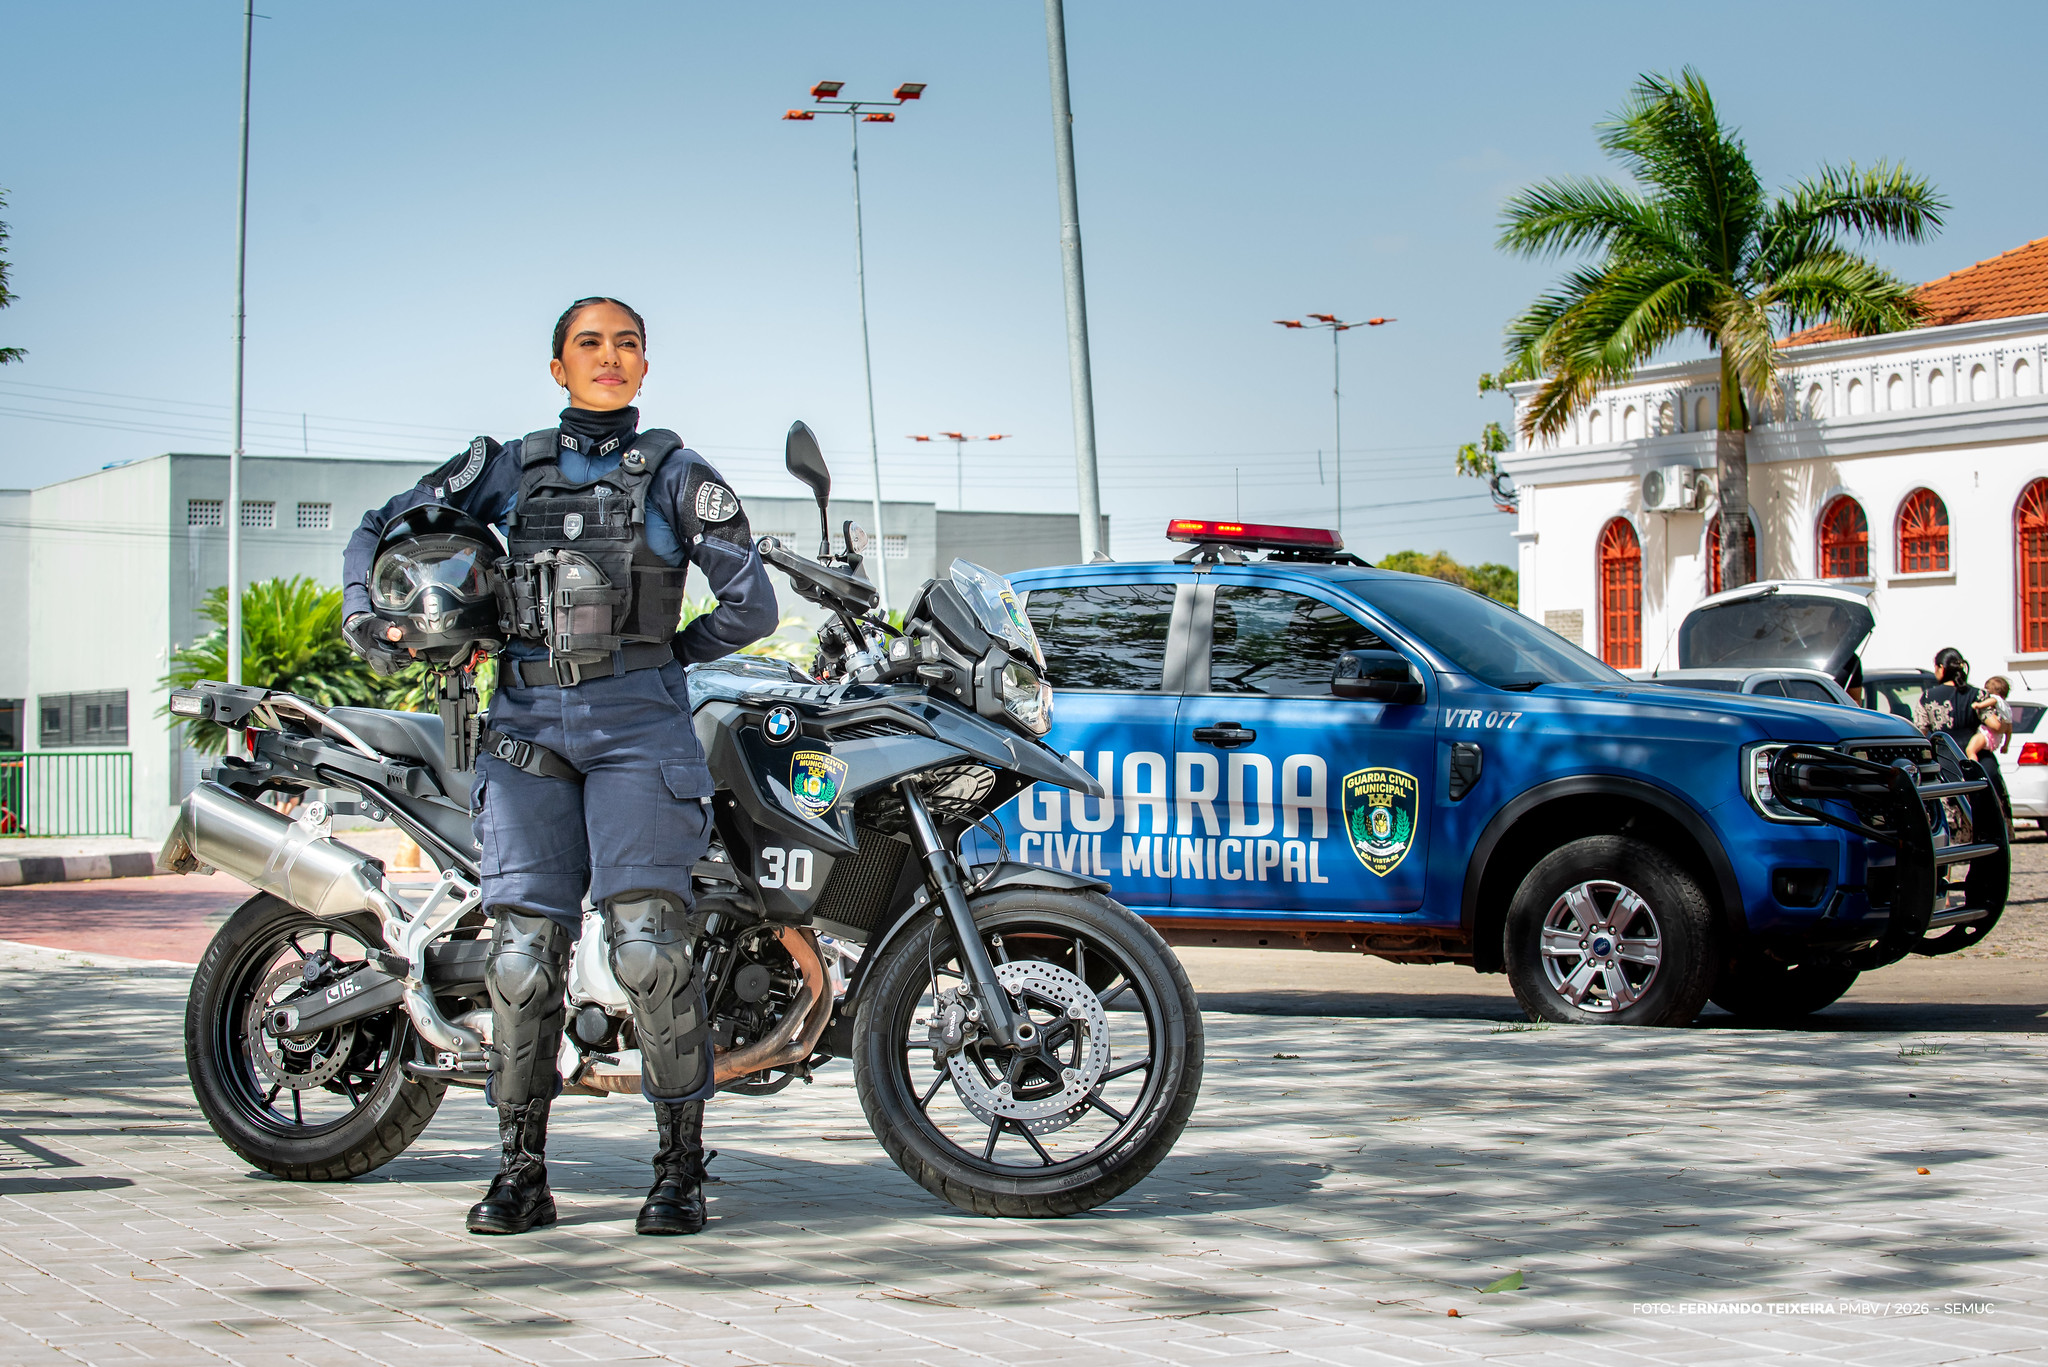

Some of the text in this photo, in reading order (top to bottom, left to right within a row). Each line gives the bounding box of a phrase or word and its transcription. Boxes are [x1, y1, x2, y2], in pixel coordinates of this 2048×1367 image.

[453, 440, 483, 488] BOA VISTA
[709, 487, 724, 519] GAM
[1445, 708, 1523, 729] VTR 077
[795, 753, 844, 772] GUARDA CIVIL
[799, 760, 837, 775] MUNICIPAL
[1347, 772, 1414, 791] GUARDA CIVIL
[1354, 783, 1407, 798] MUNICIPAL
[1018, 750, 1329, 839] GUARDA
[759, 846, 814, 891] 30
[1019, 832, 1329, 884] CIVIL MUNICIPAL
[1360, 851, 1372, 862] BOA
[946, 1011, 957, 1038] brembo
